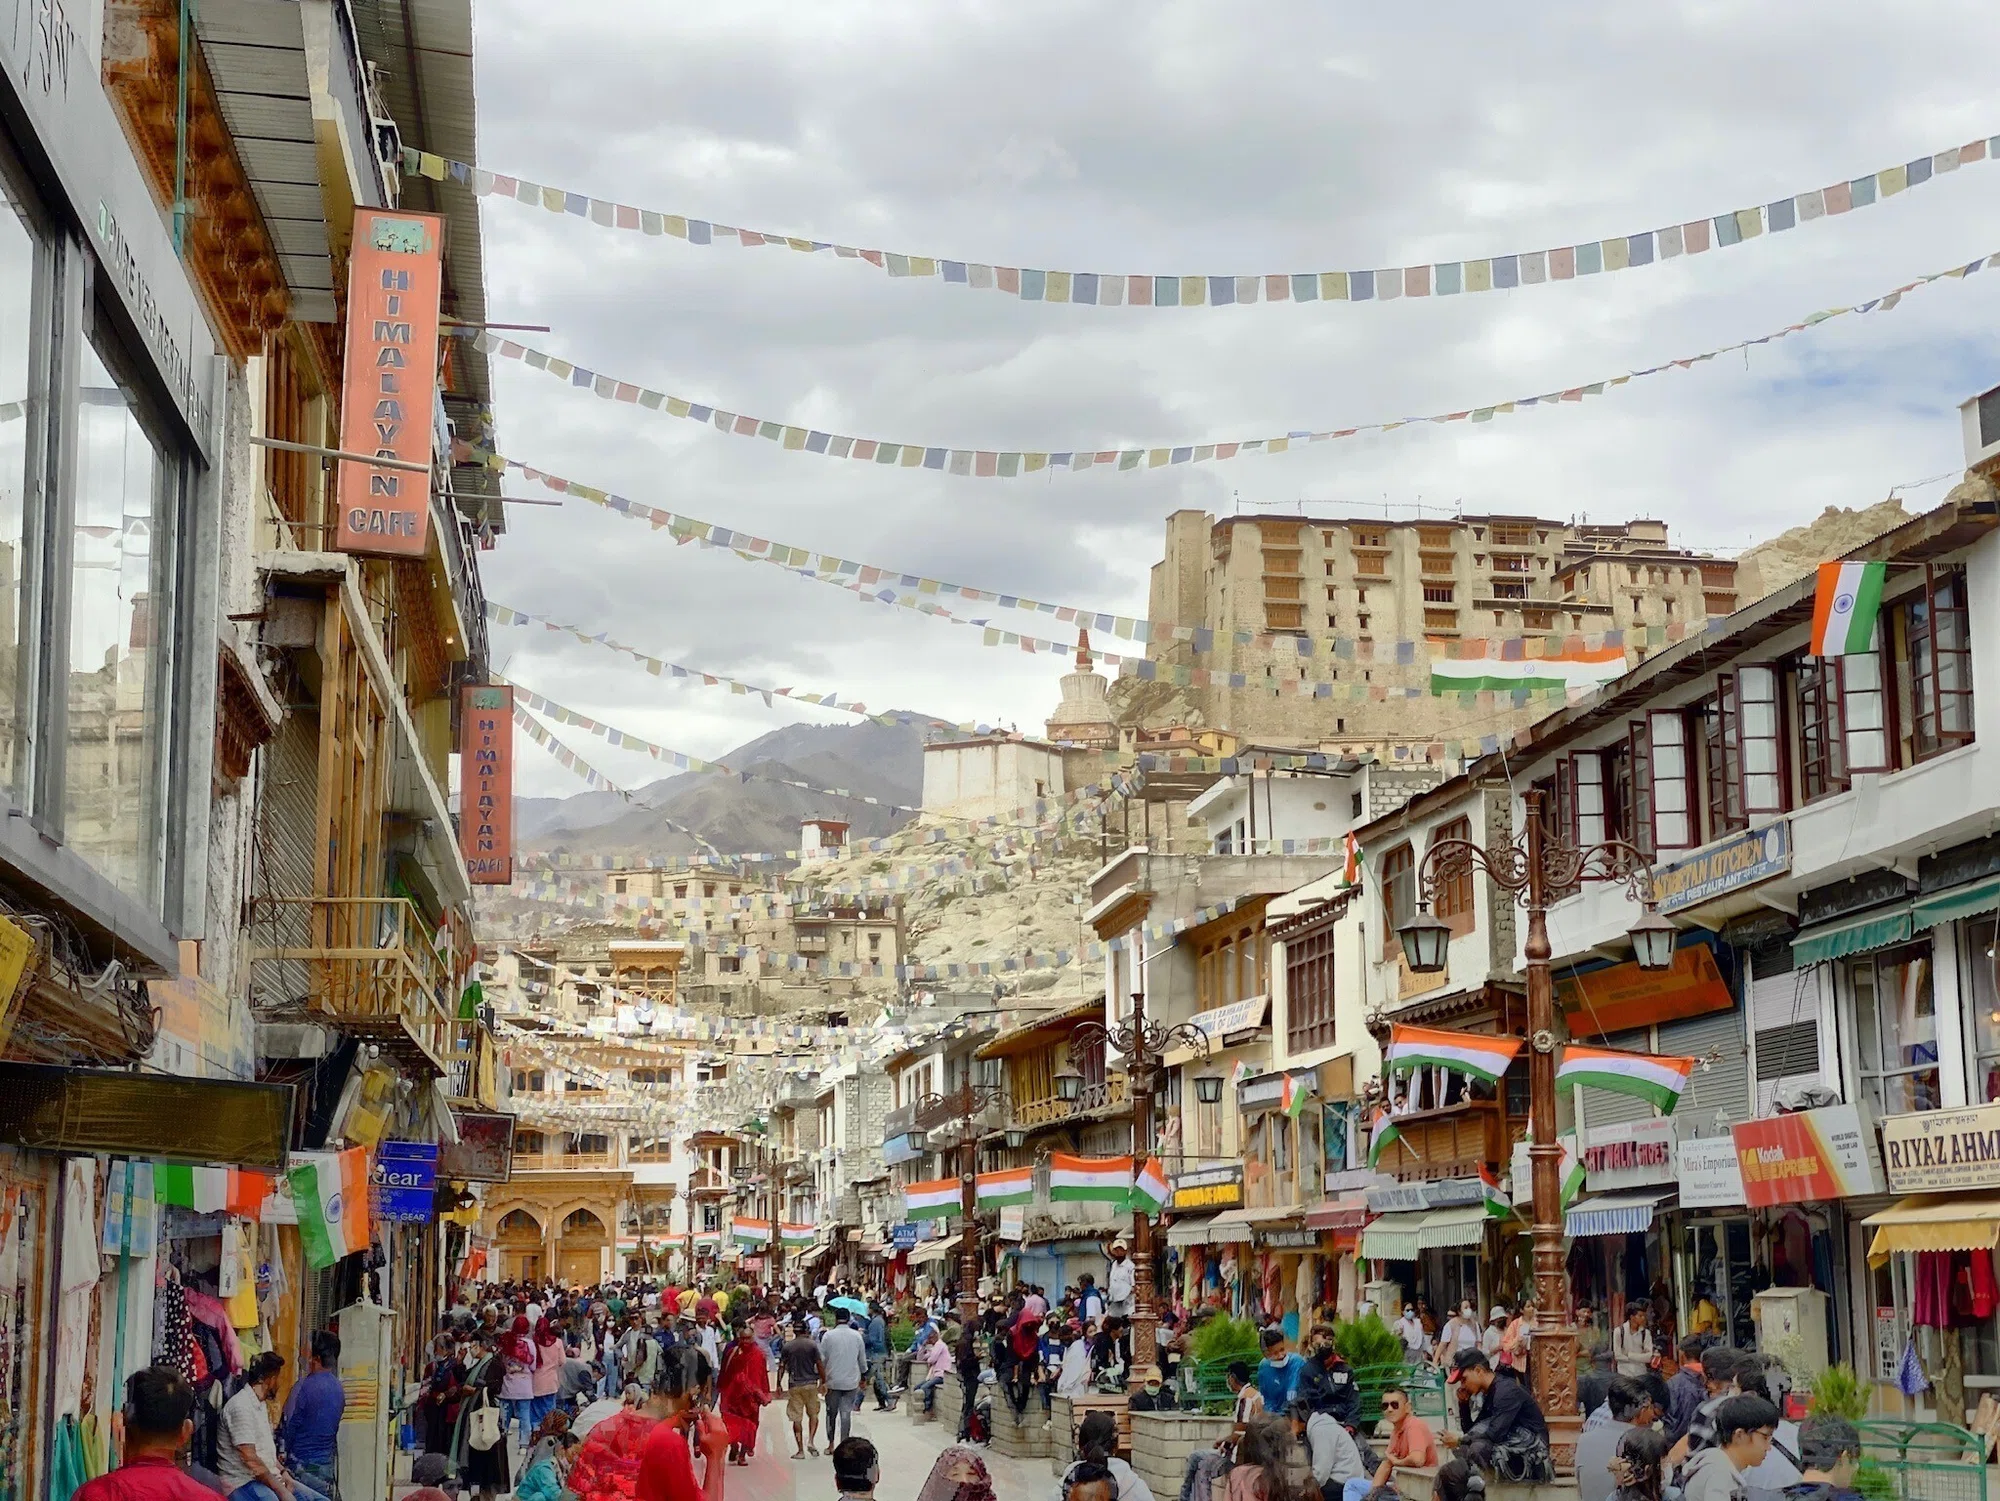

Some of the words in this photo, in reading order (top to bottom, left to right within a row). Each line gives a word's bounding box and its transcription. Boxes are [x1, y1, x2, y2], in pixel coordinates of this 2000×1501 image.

[107, 213, 135, 298] PURE
[137, 270, 157, 338] VEG
[372, 269, 412, 497] HIMALAYAN
[348, 508, 419, 537] CAFE
[475, 719, 498, 851] HIMALAYAN
[1710, 838, 1764, 881] KITCHEN
[1687, 872, 1741, 901] RESTAURANT
[1605, 1141, 1636, 1169] WALK
[1638, 1141, 1669, 1166] SHOES
[1683, 1155, 1702, 1171] Mira's
[1703, 1155, 1738, 1174] Emporium
[1757, 1144, 1785, 1163] Kodak
[1888, 1135, 1947, 1168] RIYAZ
[372, 1169, 422, 1186] Gear
[1771, 1156, 1819, 1179] EXPRESS
[400, 1213, 426, 1222] GEAR
[897, 1229, 915, 1237] ATM
